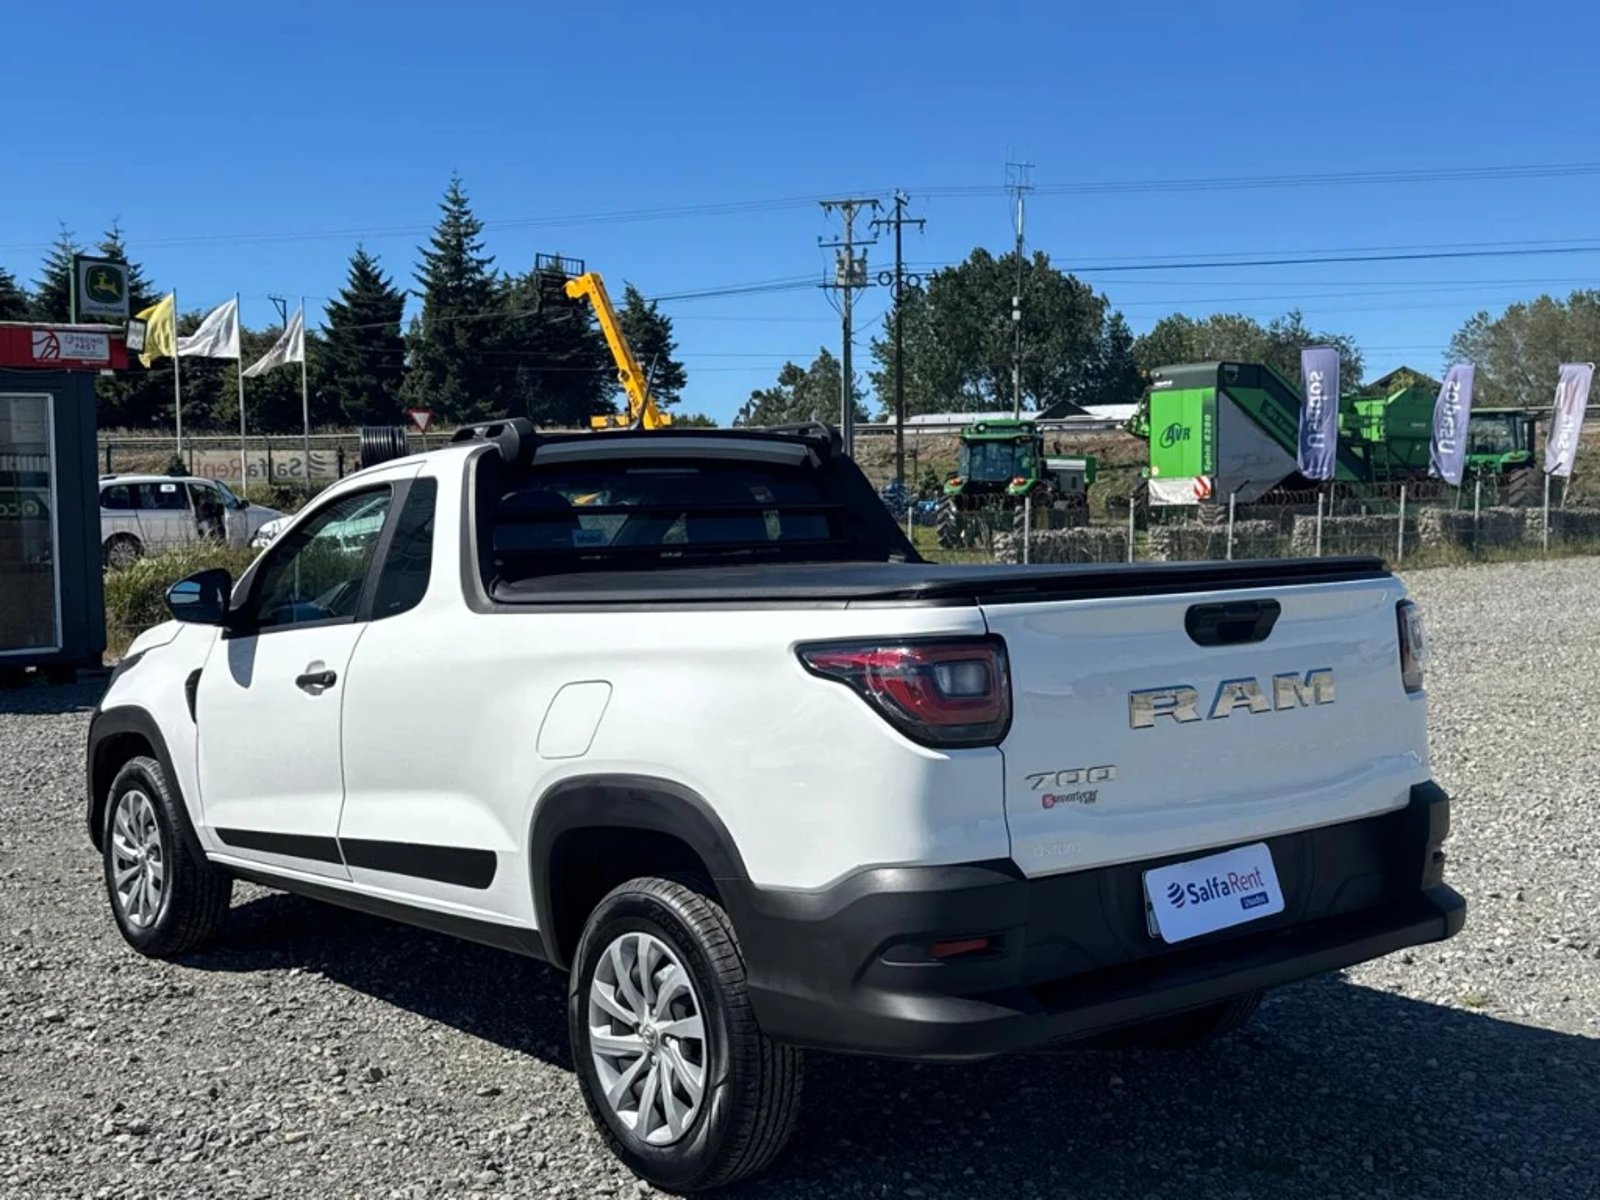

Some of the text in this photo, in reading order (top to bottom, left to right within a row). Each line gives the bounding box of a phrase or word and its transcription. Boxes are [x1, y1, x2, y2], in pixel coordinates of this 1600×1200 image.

[1163, 424, 1191, 444] AVR
[1129, 668, 1335, 729] RAM
[1024, 765, 1117, 791] 700
[1187, 866, 1264, 905] SalfaRent
